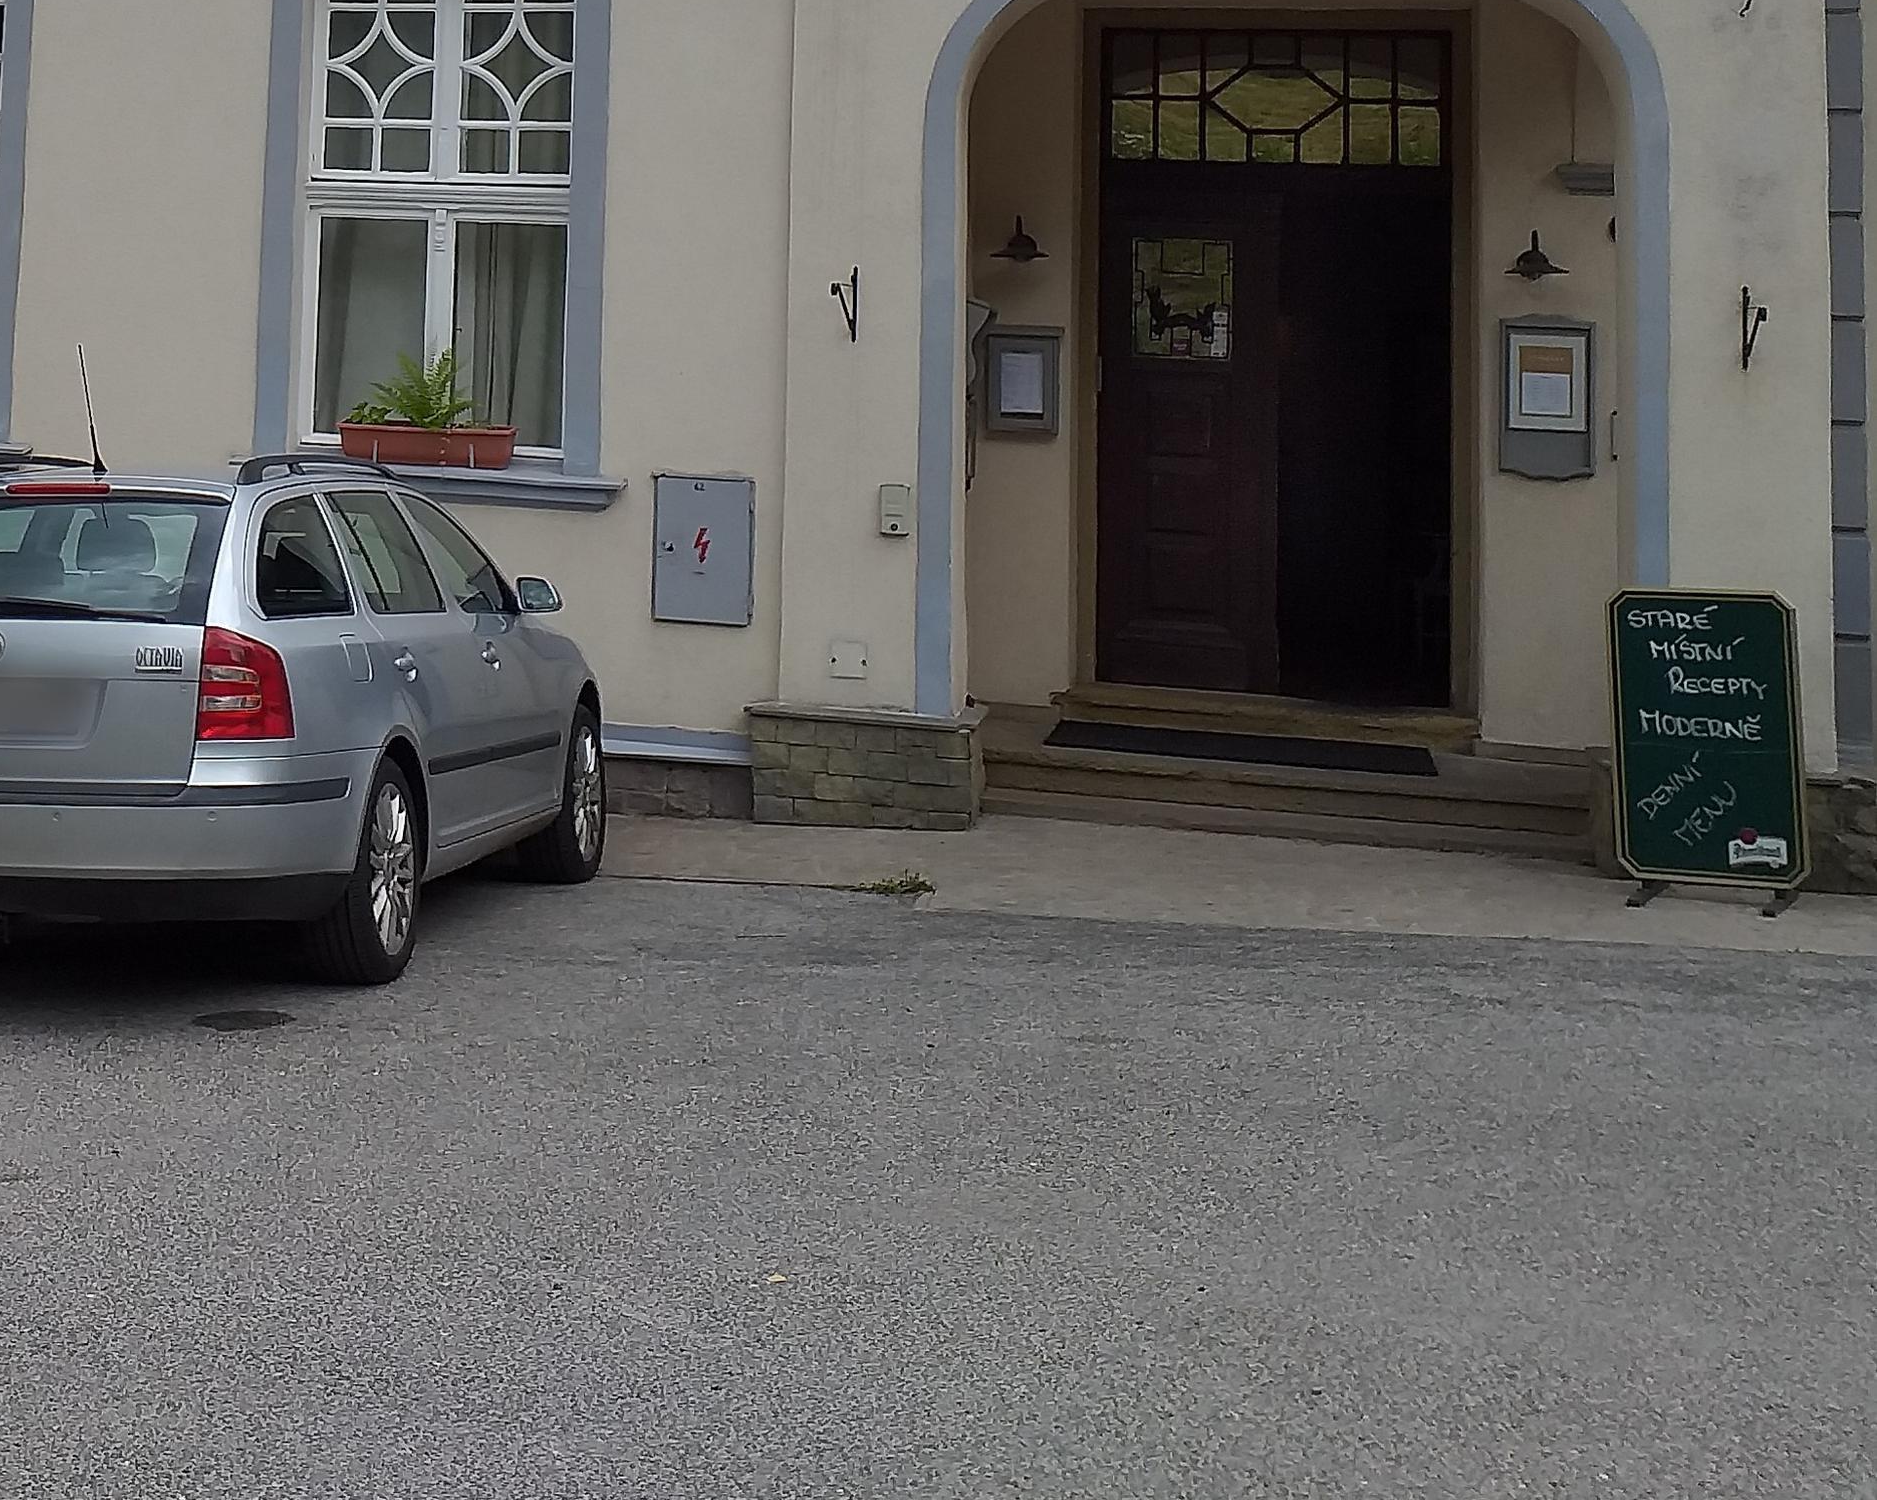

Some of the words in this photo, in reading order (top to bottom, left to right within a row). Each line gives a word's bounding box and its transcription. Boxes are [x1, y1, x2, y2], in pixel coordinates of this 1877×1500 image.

[1627, 605, 1719, 630] STARÉ
[135, 646, 183, 667] OCTAVIA
[1649, 633, 1745, 661] MÍSTNÍ
[1665, 666, 1768, 700] RECEPTY
[1638, 709, 1762, 741] MODERNĚ
[1637, 750, 1702, 820] DENNÍ
